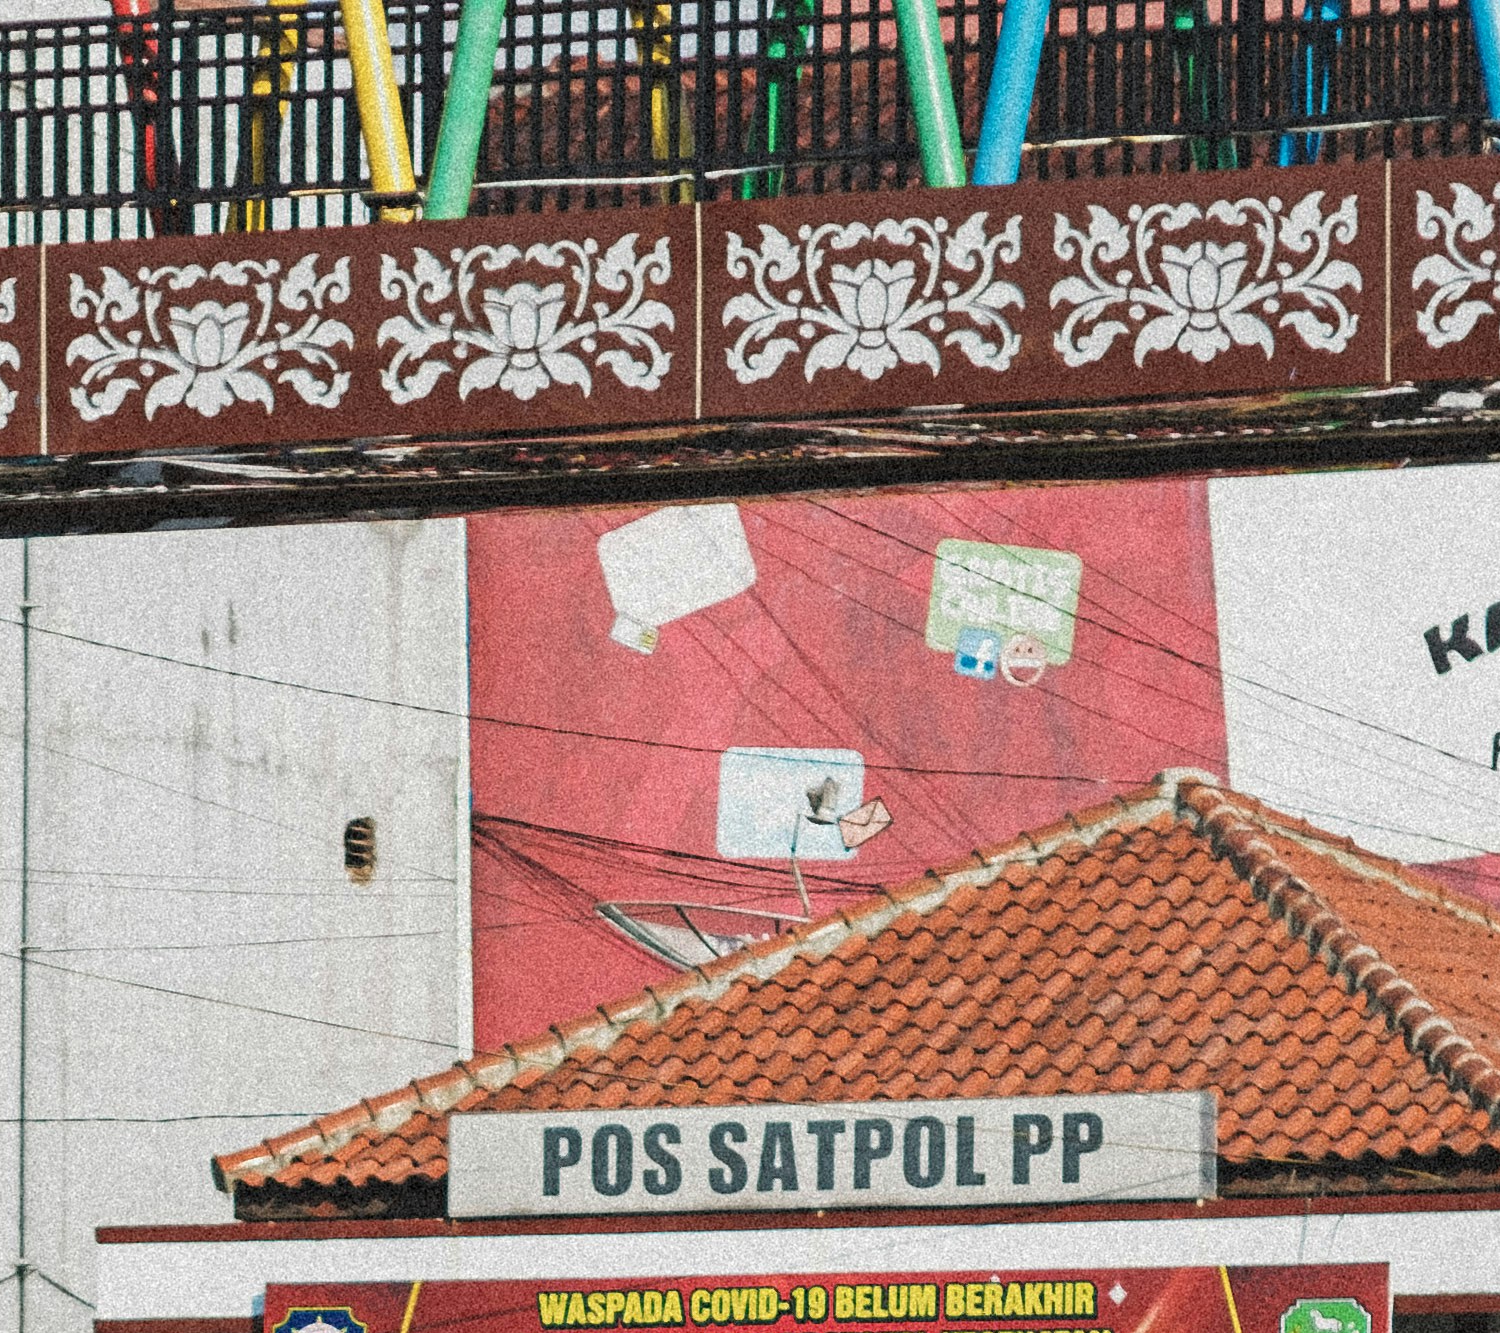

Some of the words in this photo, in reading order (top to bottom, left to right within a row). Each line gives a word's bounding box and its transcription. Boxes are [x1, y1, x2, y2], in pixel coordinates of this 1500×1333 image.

[542, 1122, 682, 1197] POS
[708, 1115, 986, 1195] SATPOL
[1012, 1111, 1103, 1186] PP
[539, 1291, 681, 1326] WASPADA
[690, 1286, 827, 1323] COVID-19
[836, 1285, 935, 1319] BELUM
[946, 1282, 1095, 1318] BERAKHIR
